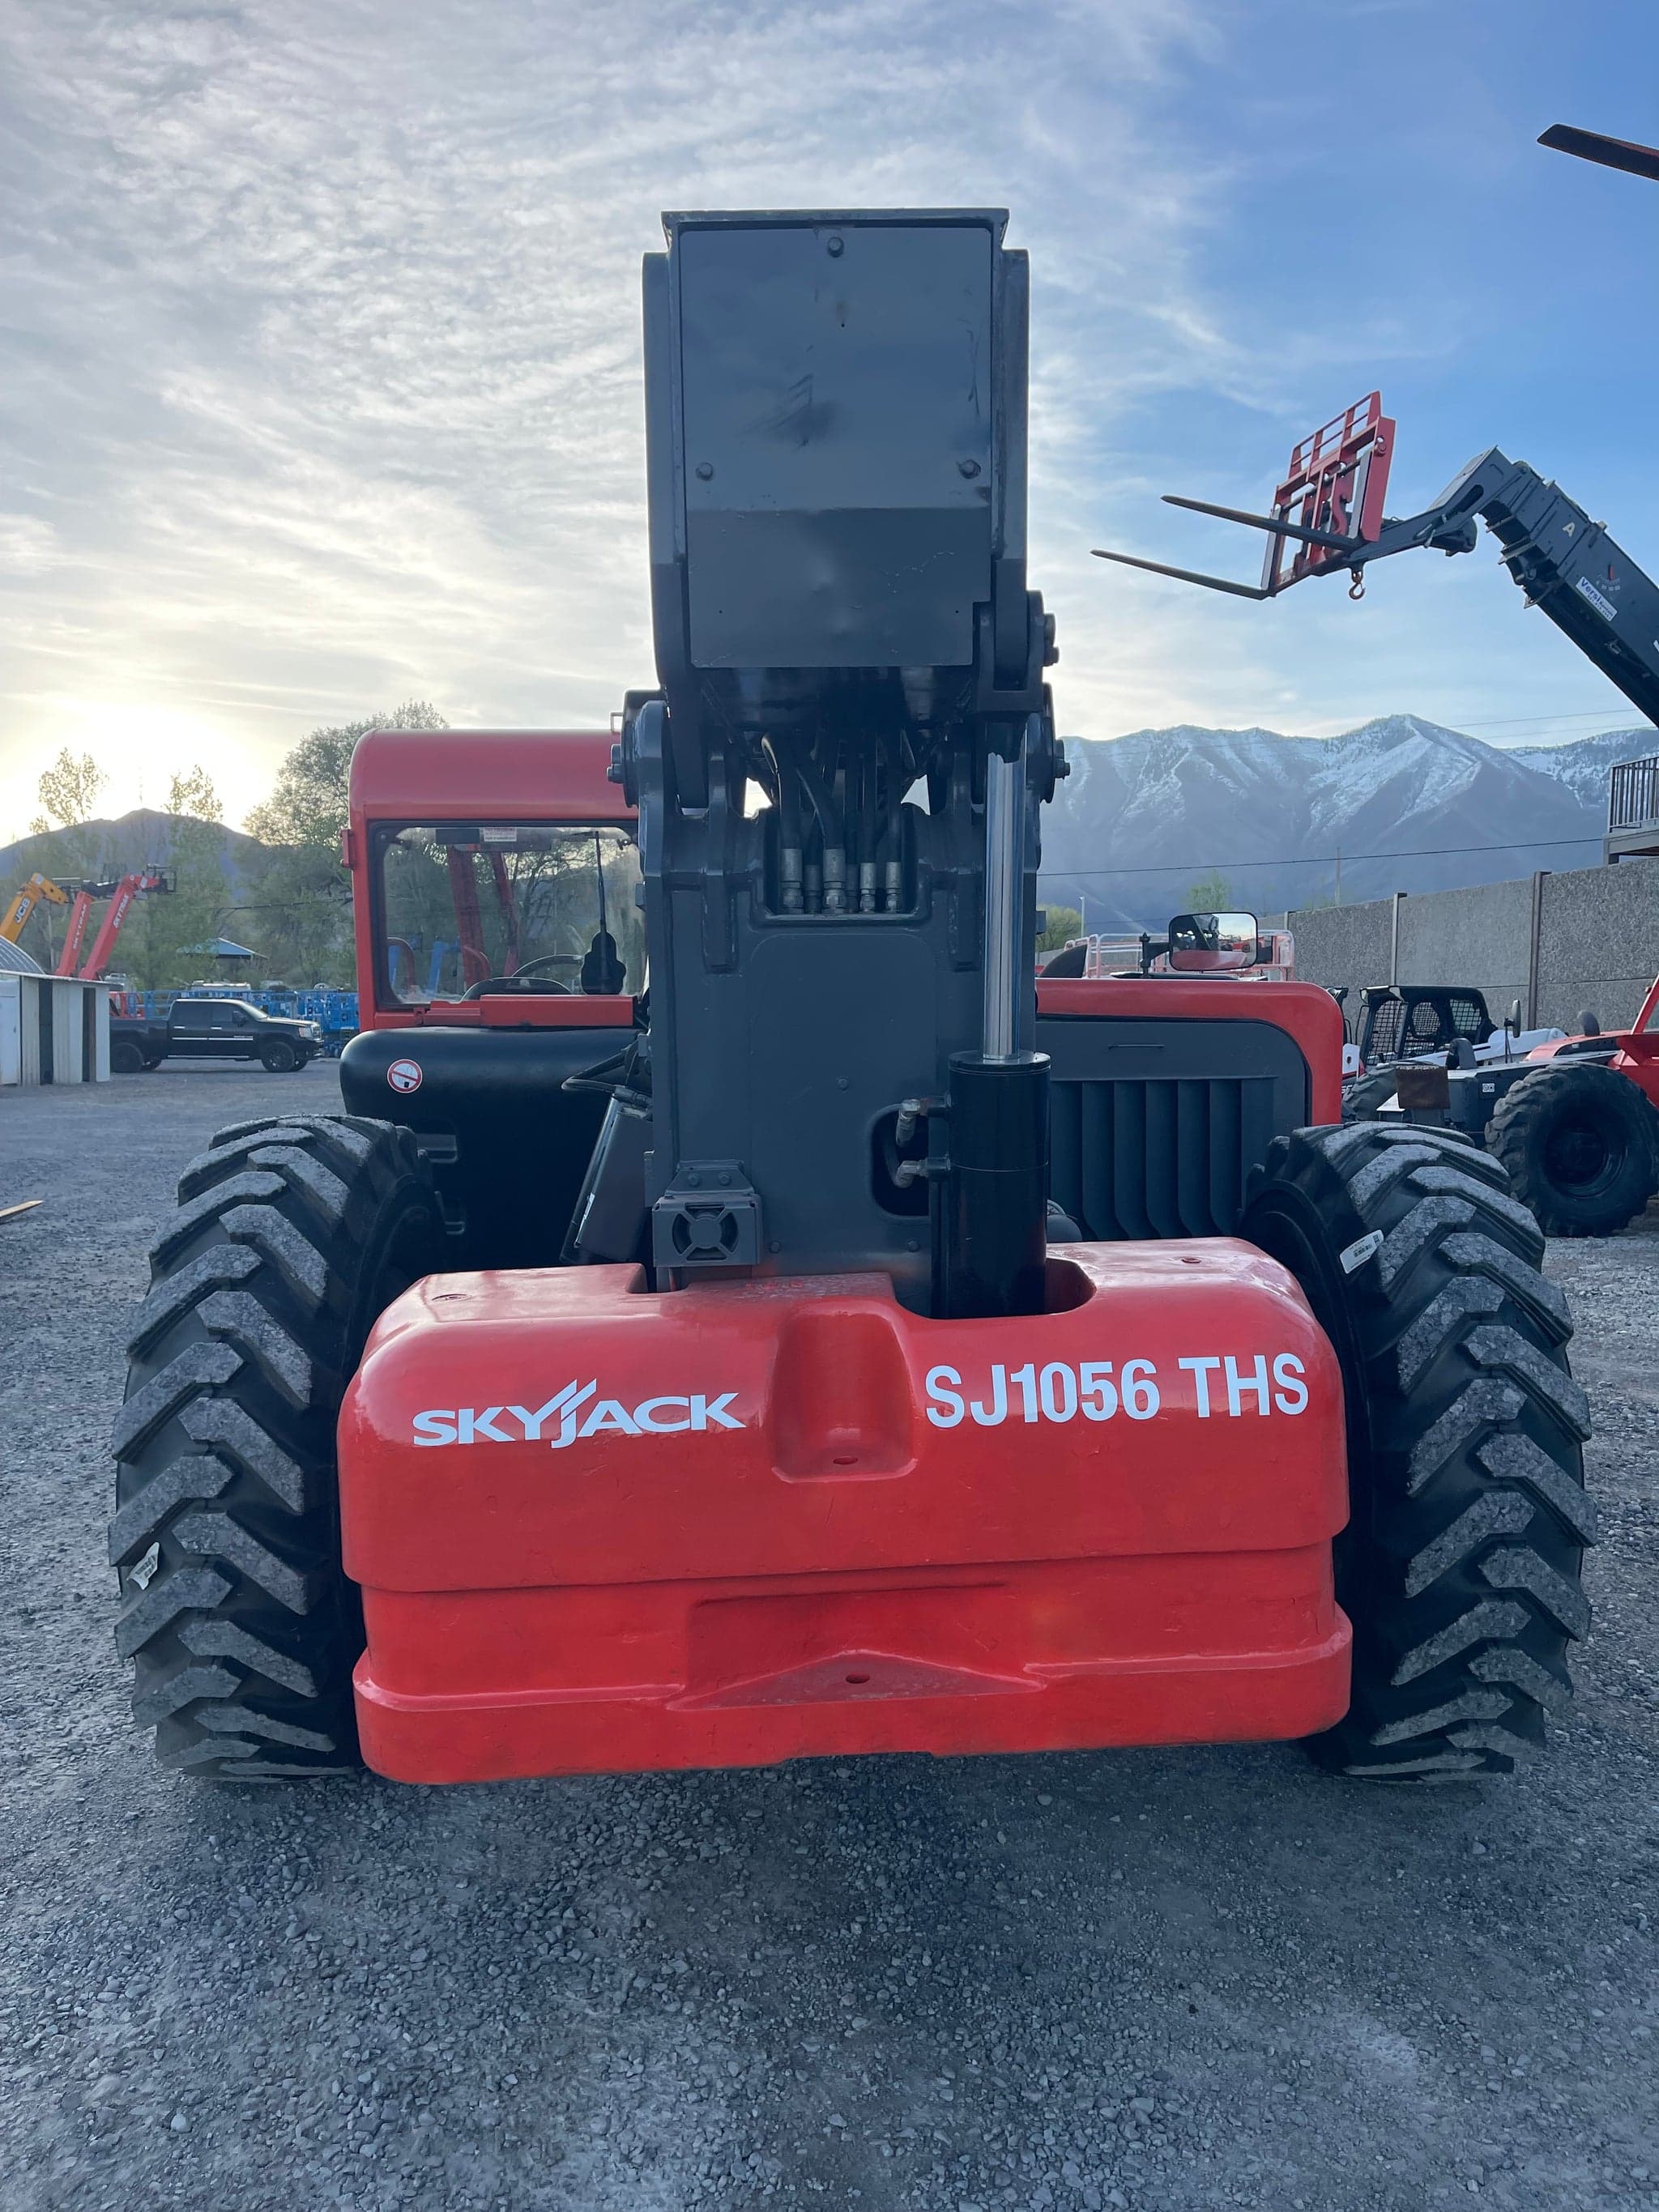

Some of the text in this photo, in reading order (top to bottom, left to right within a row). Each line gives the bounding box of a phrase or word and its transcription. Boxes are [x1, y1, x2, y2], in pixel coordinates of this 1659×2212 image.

[1562, 522, 1576, 537] A
[15, 897, 31, 923] JCB
[412, 1378, 746, 1449] SKYJACK
[925, 1353, 1309, 1428] SJ1056 THS
